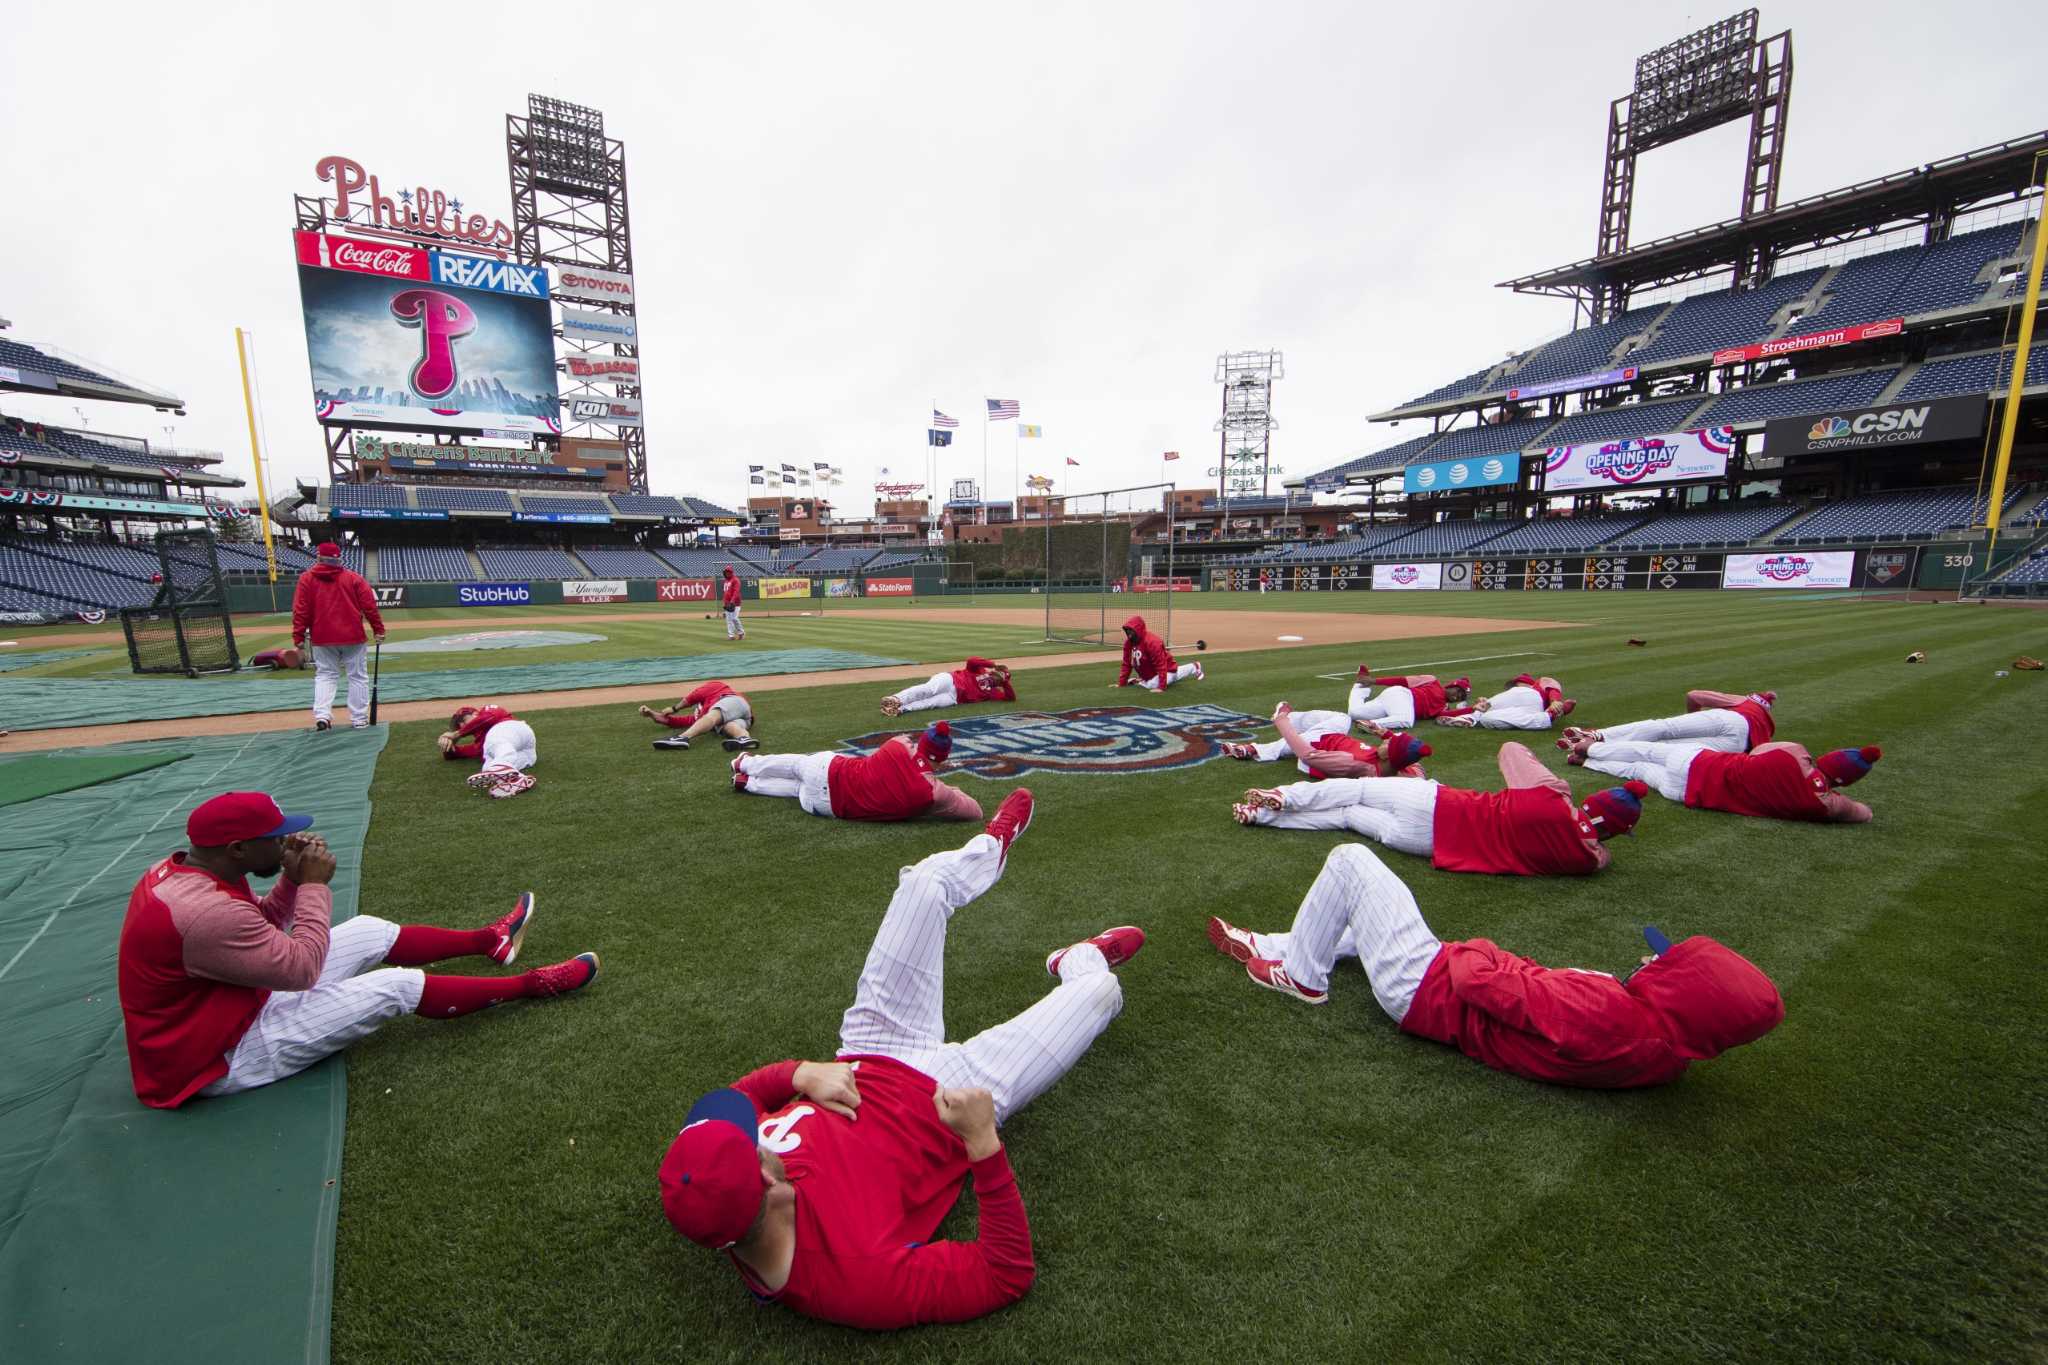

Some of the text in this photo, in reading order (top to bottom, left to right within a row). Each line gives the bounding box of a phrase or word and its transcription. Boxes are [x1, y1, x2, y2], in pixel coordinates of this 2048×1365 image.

[315, 155, 513, 246] Phillies
[335, 242, 414, 275] Coca-Cola
[439, 255, 538, 296] RE/MAX
[580, 278, 631, 295] TOYOTA
[1761, 331, 1844, 355] Stroehmann
[1853, 406, 1931, 433] CSN
[1807, 430, 1923, 450] CSNPHILLY.COM
[388, 442, 553, 465] Citizens Bank Park
[1588, 449, 1646, 469] OPENING
[1648, 445, 1679, 462] DAY
[1207, 464, 1284, 477] Citizens Bank
[1232, 478, 1257, 488] Park
[1756, 560, 1814, 573] OPENING DAY
[1943, 555, 1973, 567] 330
[460, 587, 529, 602] StubHub
[582, 595, 609, 603] LAGER
[661, 582, 710, 599] xfinity
